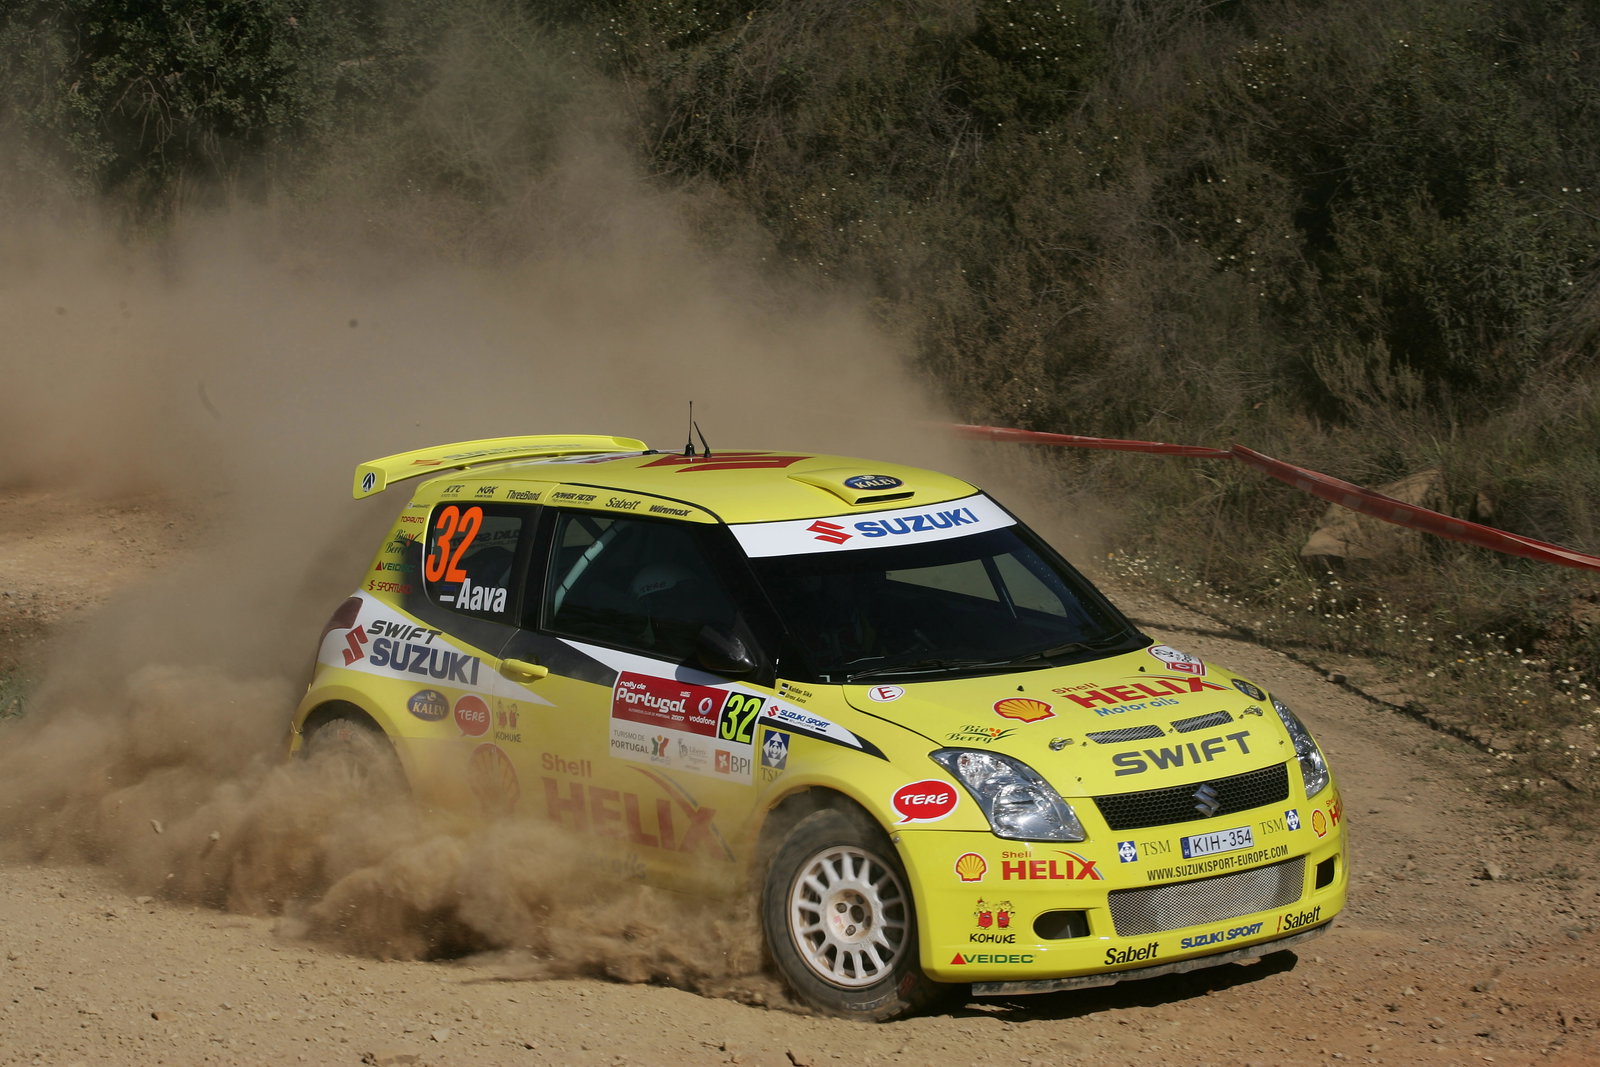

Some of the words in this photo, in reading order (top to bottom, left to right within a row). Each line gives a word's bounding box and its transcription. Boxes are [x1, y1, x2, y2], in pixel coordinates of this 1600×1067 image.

[444, 485, 465, 494] KTC
[477, 486, 498, 495] NGK
[853, 478, 898, 490] KALEV
[506, 490, 542, 501] ThreeBond
[552, 492, 575, 501] POWER
[575, 493, 597, 502] FILTER
[605, 497, 642, 510] Sabelt
[649, 505, 692, 517] Winmax
[400, 515, 424, 524] TOPAUTO
[853, 507, 980, 538] SUZUKI
[425, 505, 483, 583] 32
[455, 578, 507, 612] Aava
[366, 619, 444, 645] SWIFT
[369, 637, 481, 686] SUZUKI
[620, 681, 637, 690] rally
[877, 686, 896, 700] E
[1052, 682, 1099, 695] Shell
[1061, 676, 1228, 709] HELIX
[616, 688, 686, 713] Portugal
[1093, 703, 1149, 717] Motor
[1150, 697, 1180, 707] oils
[412, 701, 446, 717] KALEV
[458, 709, 485, 723] TERE
[689, 715, 716, 726] vodafone
[721, 694, 762, 744] 32
[780, 709, 807, 722] SUZUKI
[805, 717, 831, 729] SPORT
[614, 729, 635, 740] TURISMO
[635, 733, 646, 741] DE
[959, 724, 989, 733] Bio
[495, 731, 522, 743] KOHUKE
[945, 733, 992, 745] Berry
[611, 740, 650, 755] PORTUGAL
[1113, 731, 1253, 777] SWIFT
[541, 751, 592, 778] Shell
[731, 758, 751, 776] BPI
[900, 792, 949, 806] TERE
[541, 775, 730, 862] HELIX
[1259, 817, 1285, 836] TSM
[1140, 840, 1171, 857] TSM
[1192, 828, 1252, 854] KIH-354
[1001, 851, 1032, 859] Shell
[1147, 844, 1289, 881] WWW.SUZUKISPORT-EUROPE.COM
[1001, 858, 1102, 880] HELIX
[1283, 904, 1321, 932] Sabelt
[969, 933, 1017, 944] KOHUKE
[1181, 931, 1225, 949] SUZUKI
[1226, 922, 1264, 941] SPORT
[963, 954, 1035, 964] VEIDEC
[1104, 941, 1160, 966] Sabelt
